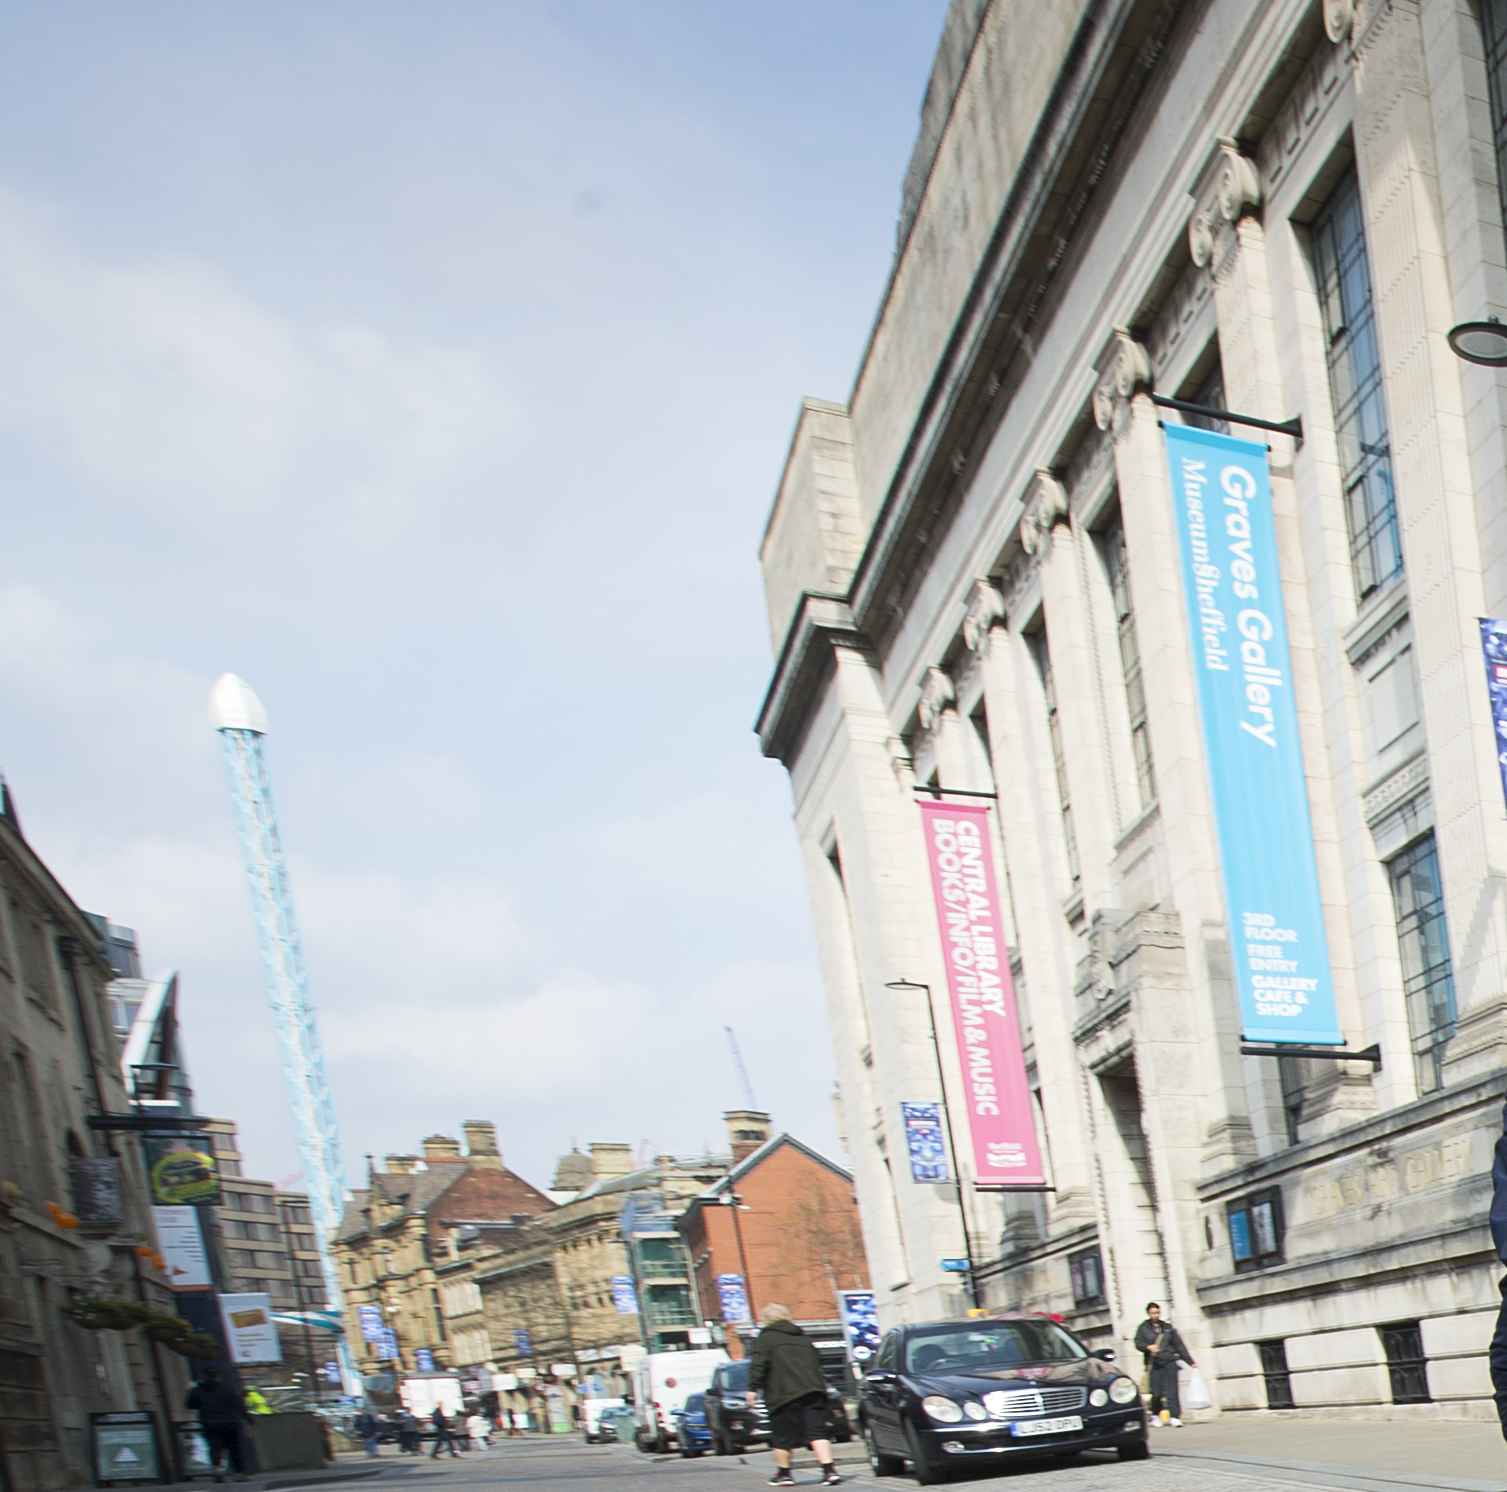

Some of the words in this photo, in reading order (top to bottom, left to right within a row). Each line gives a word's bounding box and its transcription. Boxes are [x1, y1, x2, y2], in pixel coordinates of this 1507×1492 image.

[1219, 464, 1259, 600] Graves
[1236, 608, 1283, 748] Gallery
[955, 820, 992, 922] CENTRAL
[1241, 911, 1276, 927] 3RD
[1244, 926, 1299, 943] FLOOR
[1246, 943, 1284, 959] FREE
[969, 924, 1006, 1017] LIBRARY
[1248, 957, 1299, 973] ENTRY
[1251, 974, 1319, 991] GALLERY
[1253, 988, 1293, 1004] CAFE
[1294, 990, 1309, 1005] &
[1255, 1002, 1303, 1018] SHOP
